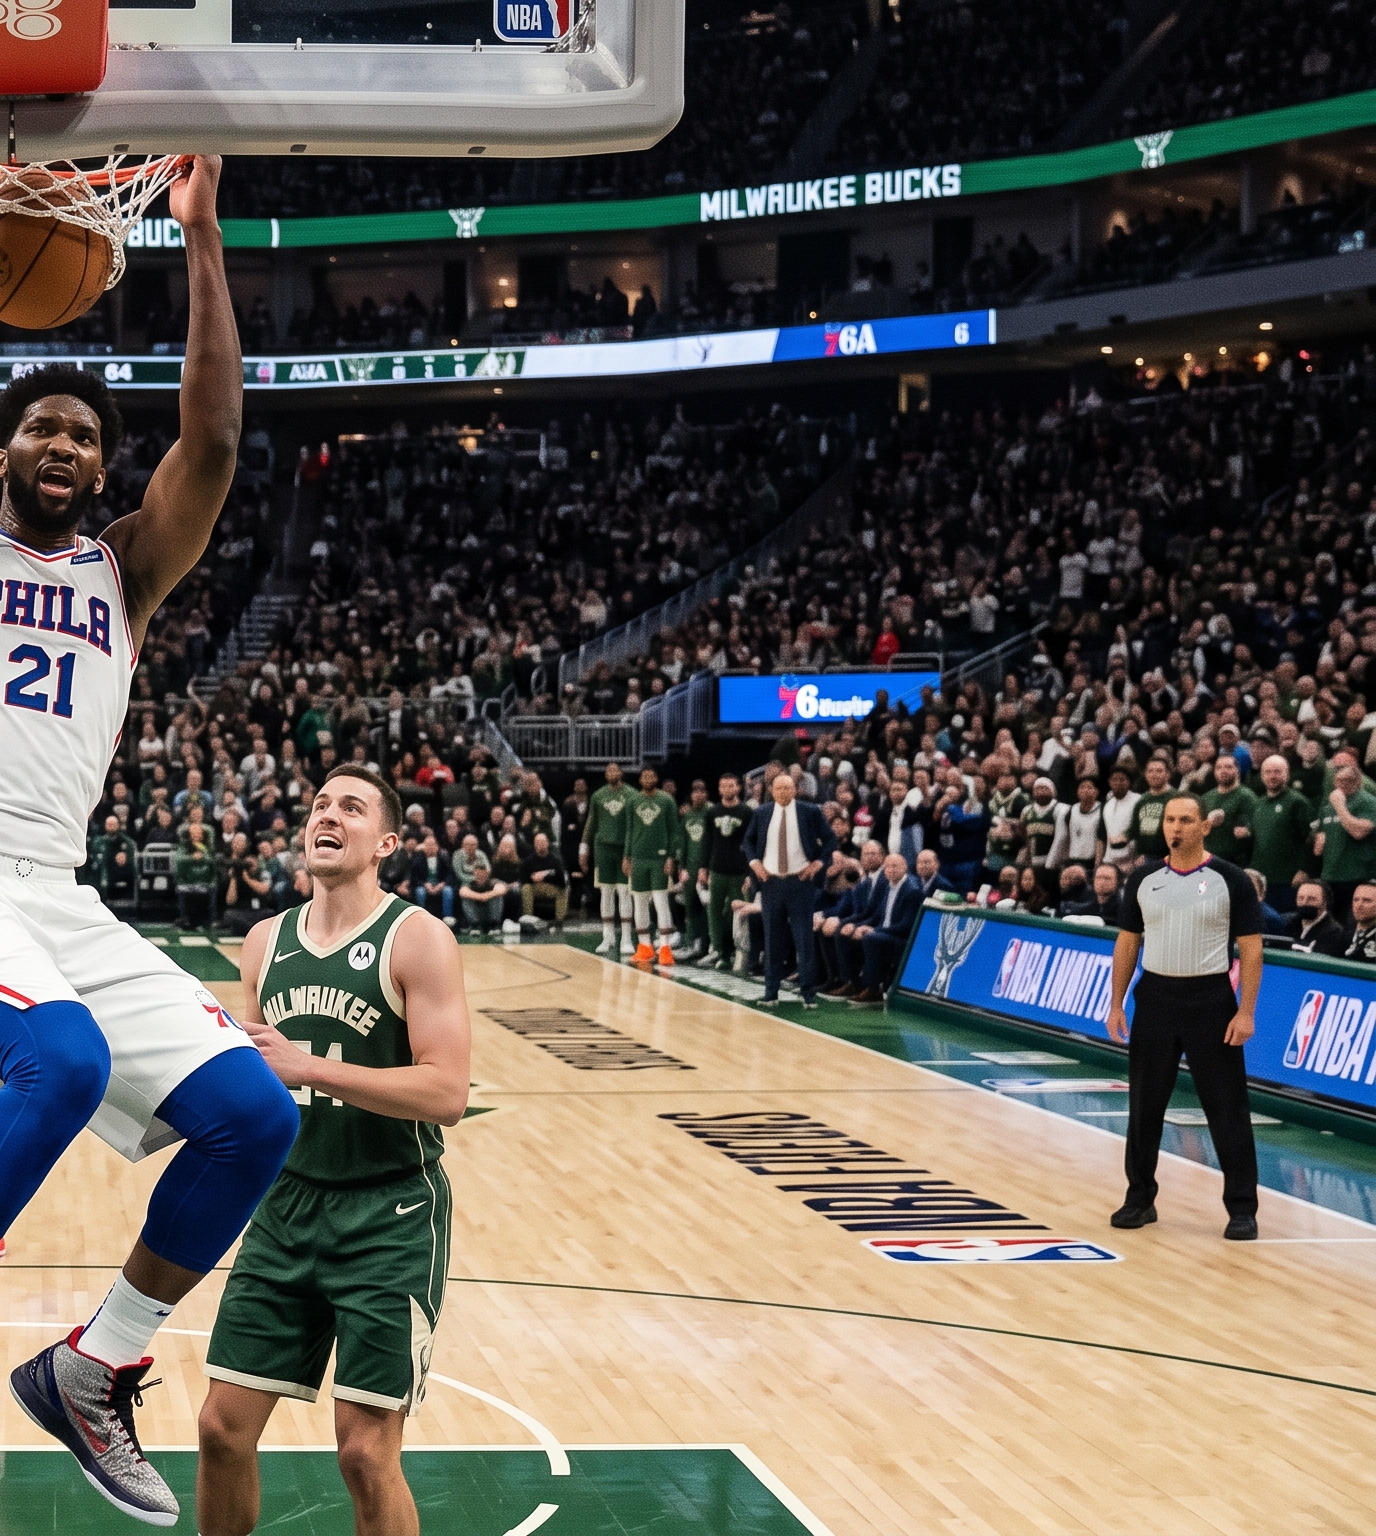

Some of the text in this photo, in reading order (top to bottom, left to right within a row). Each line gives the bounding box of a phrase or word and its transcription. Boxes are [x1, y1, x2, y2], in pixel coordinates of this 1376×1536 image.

[506, 4, 542, 31] NBA
[700, 164, 962, 223] MILWAUKEE BUCKS
[954, 322, 970, 345] 6
[104, 363, 133, 382] 64
[4, 643, 76, 719] 21
[779, 684, 819, 719] 76
[262, 985, 382, 1037] MILWAUKEE
[1304, 994, 1376, 1082] NBA
[774, 1180, 1053, 1232] NBA
